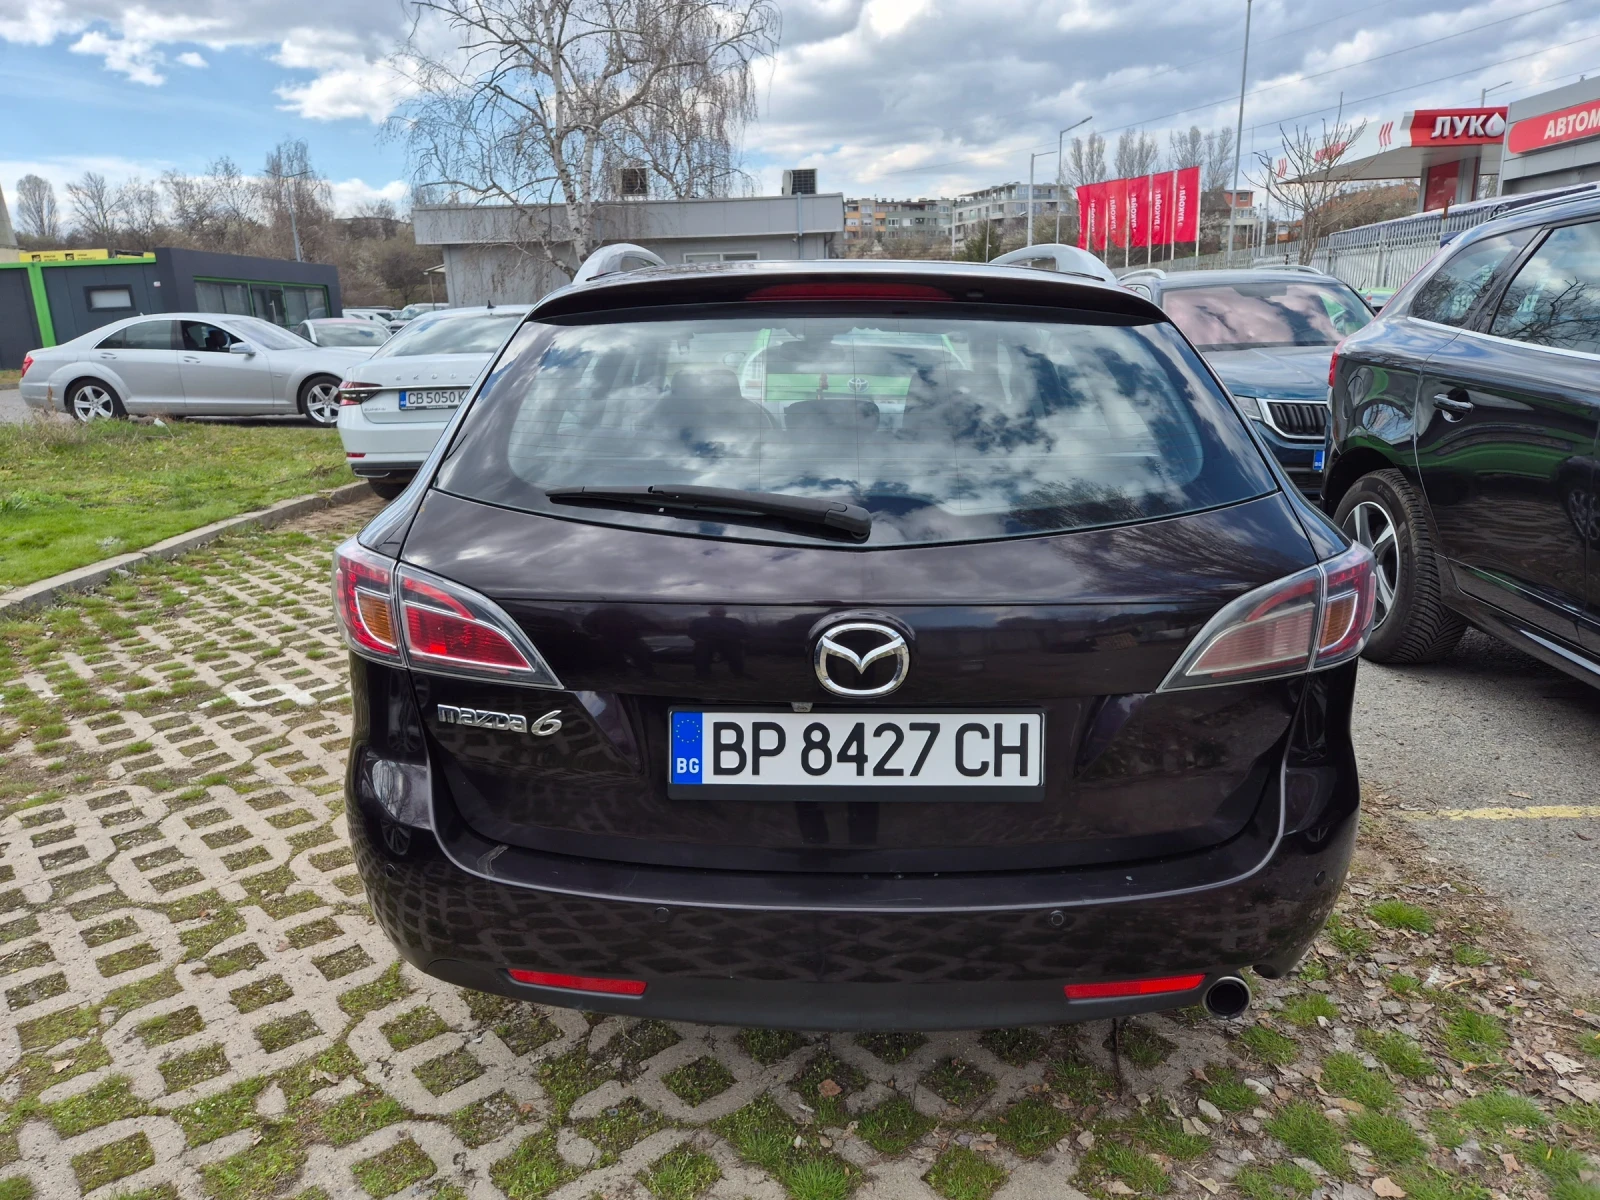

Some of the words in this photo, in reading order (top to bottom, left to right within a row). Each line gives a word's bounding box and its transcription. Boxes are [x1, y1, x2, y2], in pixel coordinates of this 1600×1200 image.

[408, 392, 424, 405] CB
[426, 391, 456, 404] 5050
[531, 710, 563, 736] 6
[712, 721, 787, 776] BP
[801, 722, 941, 777] 8427
[955, 723, 1029, 777] CH
[676, 757, 700, 774] BG
